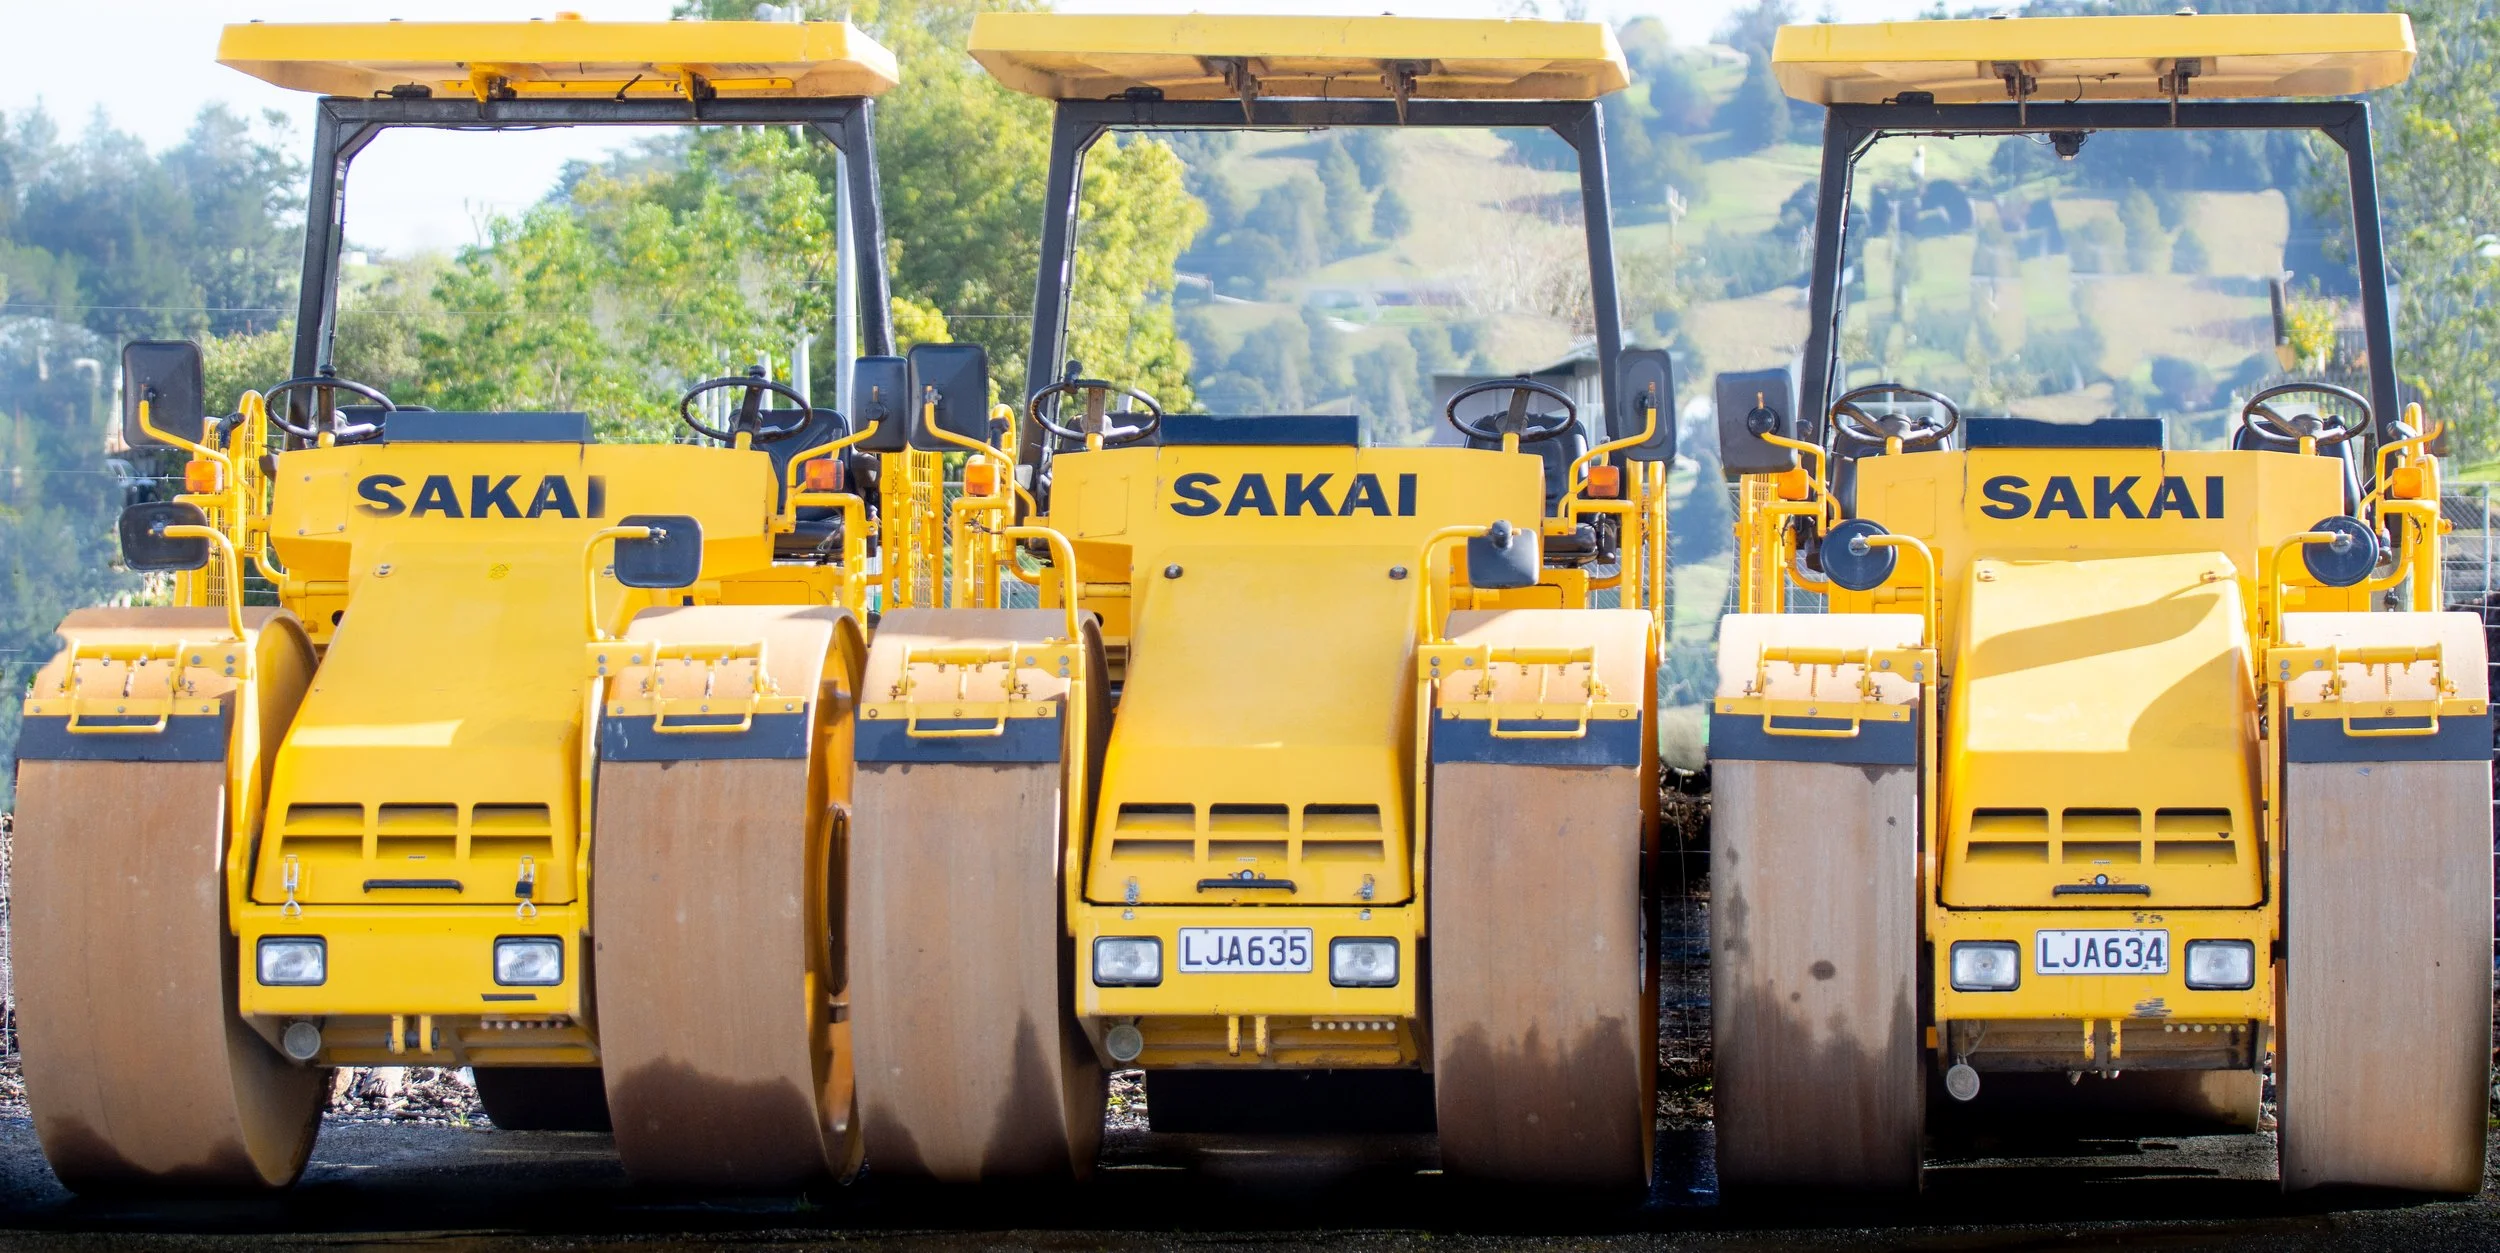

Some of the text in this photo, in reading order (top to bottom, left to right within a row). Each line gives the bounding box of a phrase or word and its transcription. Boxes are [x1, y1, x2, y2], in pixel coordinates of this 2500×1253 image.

[354, 473, 607, 519] SAKAI
[1170, 472, 1418, 517] SAKAI
[1980, 475, 2225, 520] SAKAI
[1185, 935, 1308, 966] LJA635
[2042, 937, 2164, 968] LJA634
